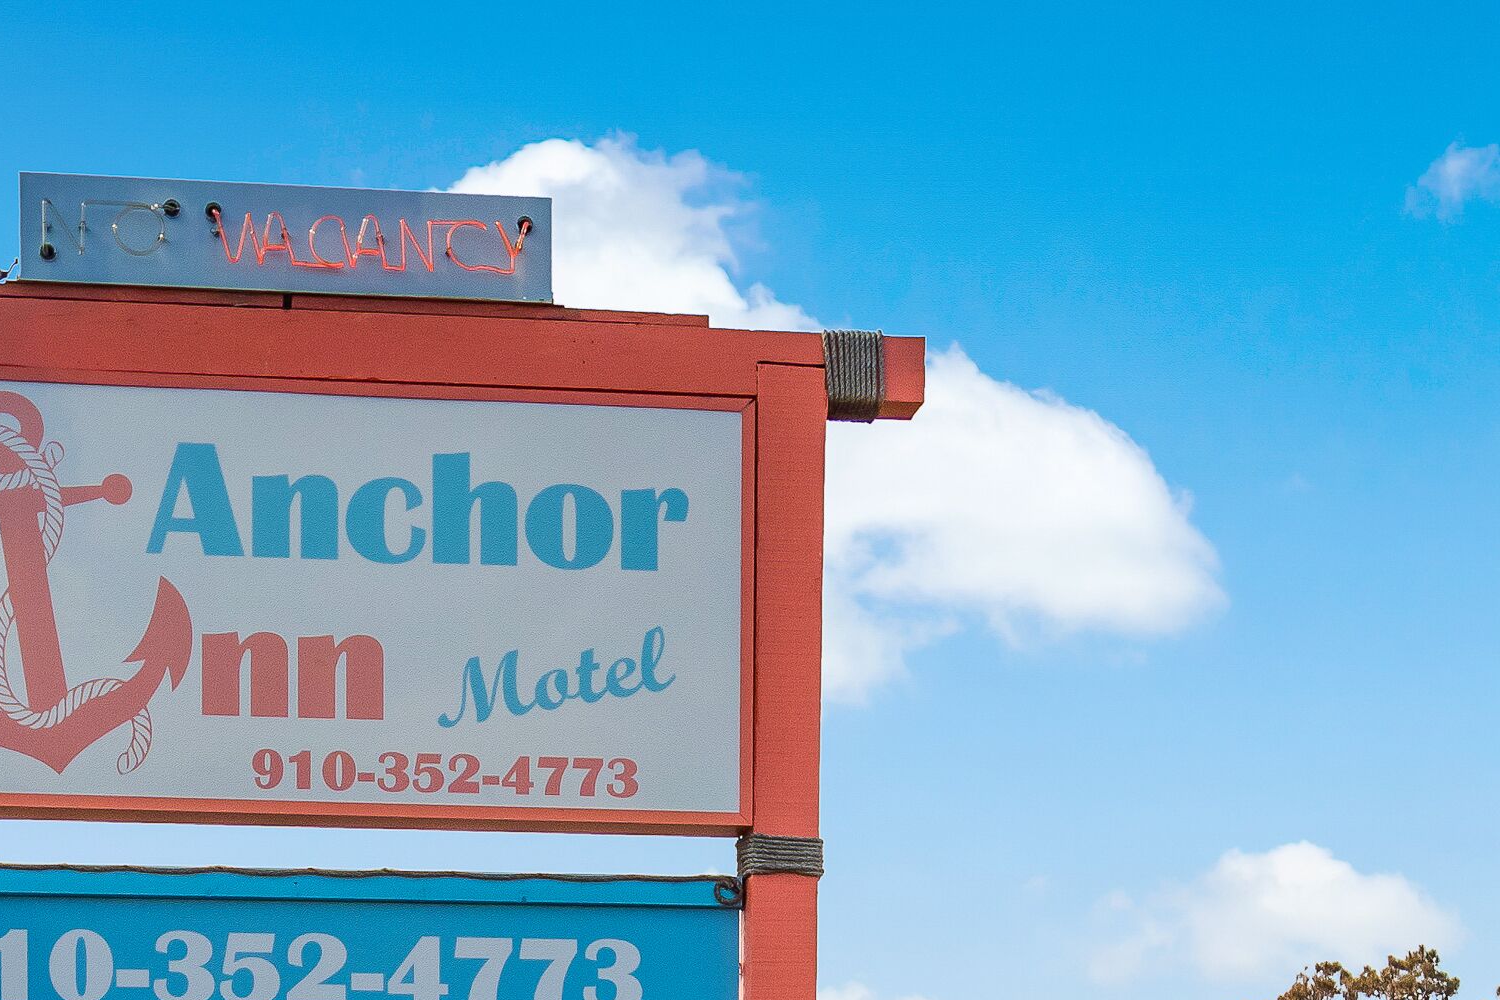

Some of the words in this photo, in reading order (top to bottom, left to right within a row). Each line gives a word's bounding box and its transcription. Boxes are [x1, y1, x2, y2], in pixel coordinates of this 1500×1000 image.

[41, 198, 167, 257] NO
[206, 206, 534, 274] VACANCY
[146, 441, 690, 572] Anchor
[438, 626, 676, 729] Motel
[252, 748, 639, 799] 910-352-4773
